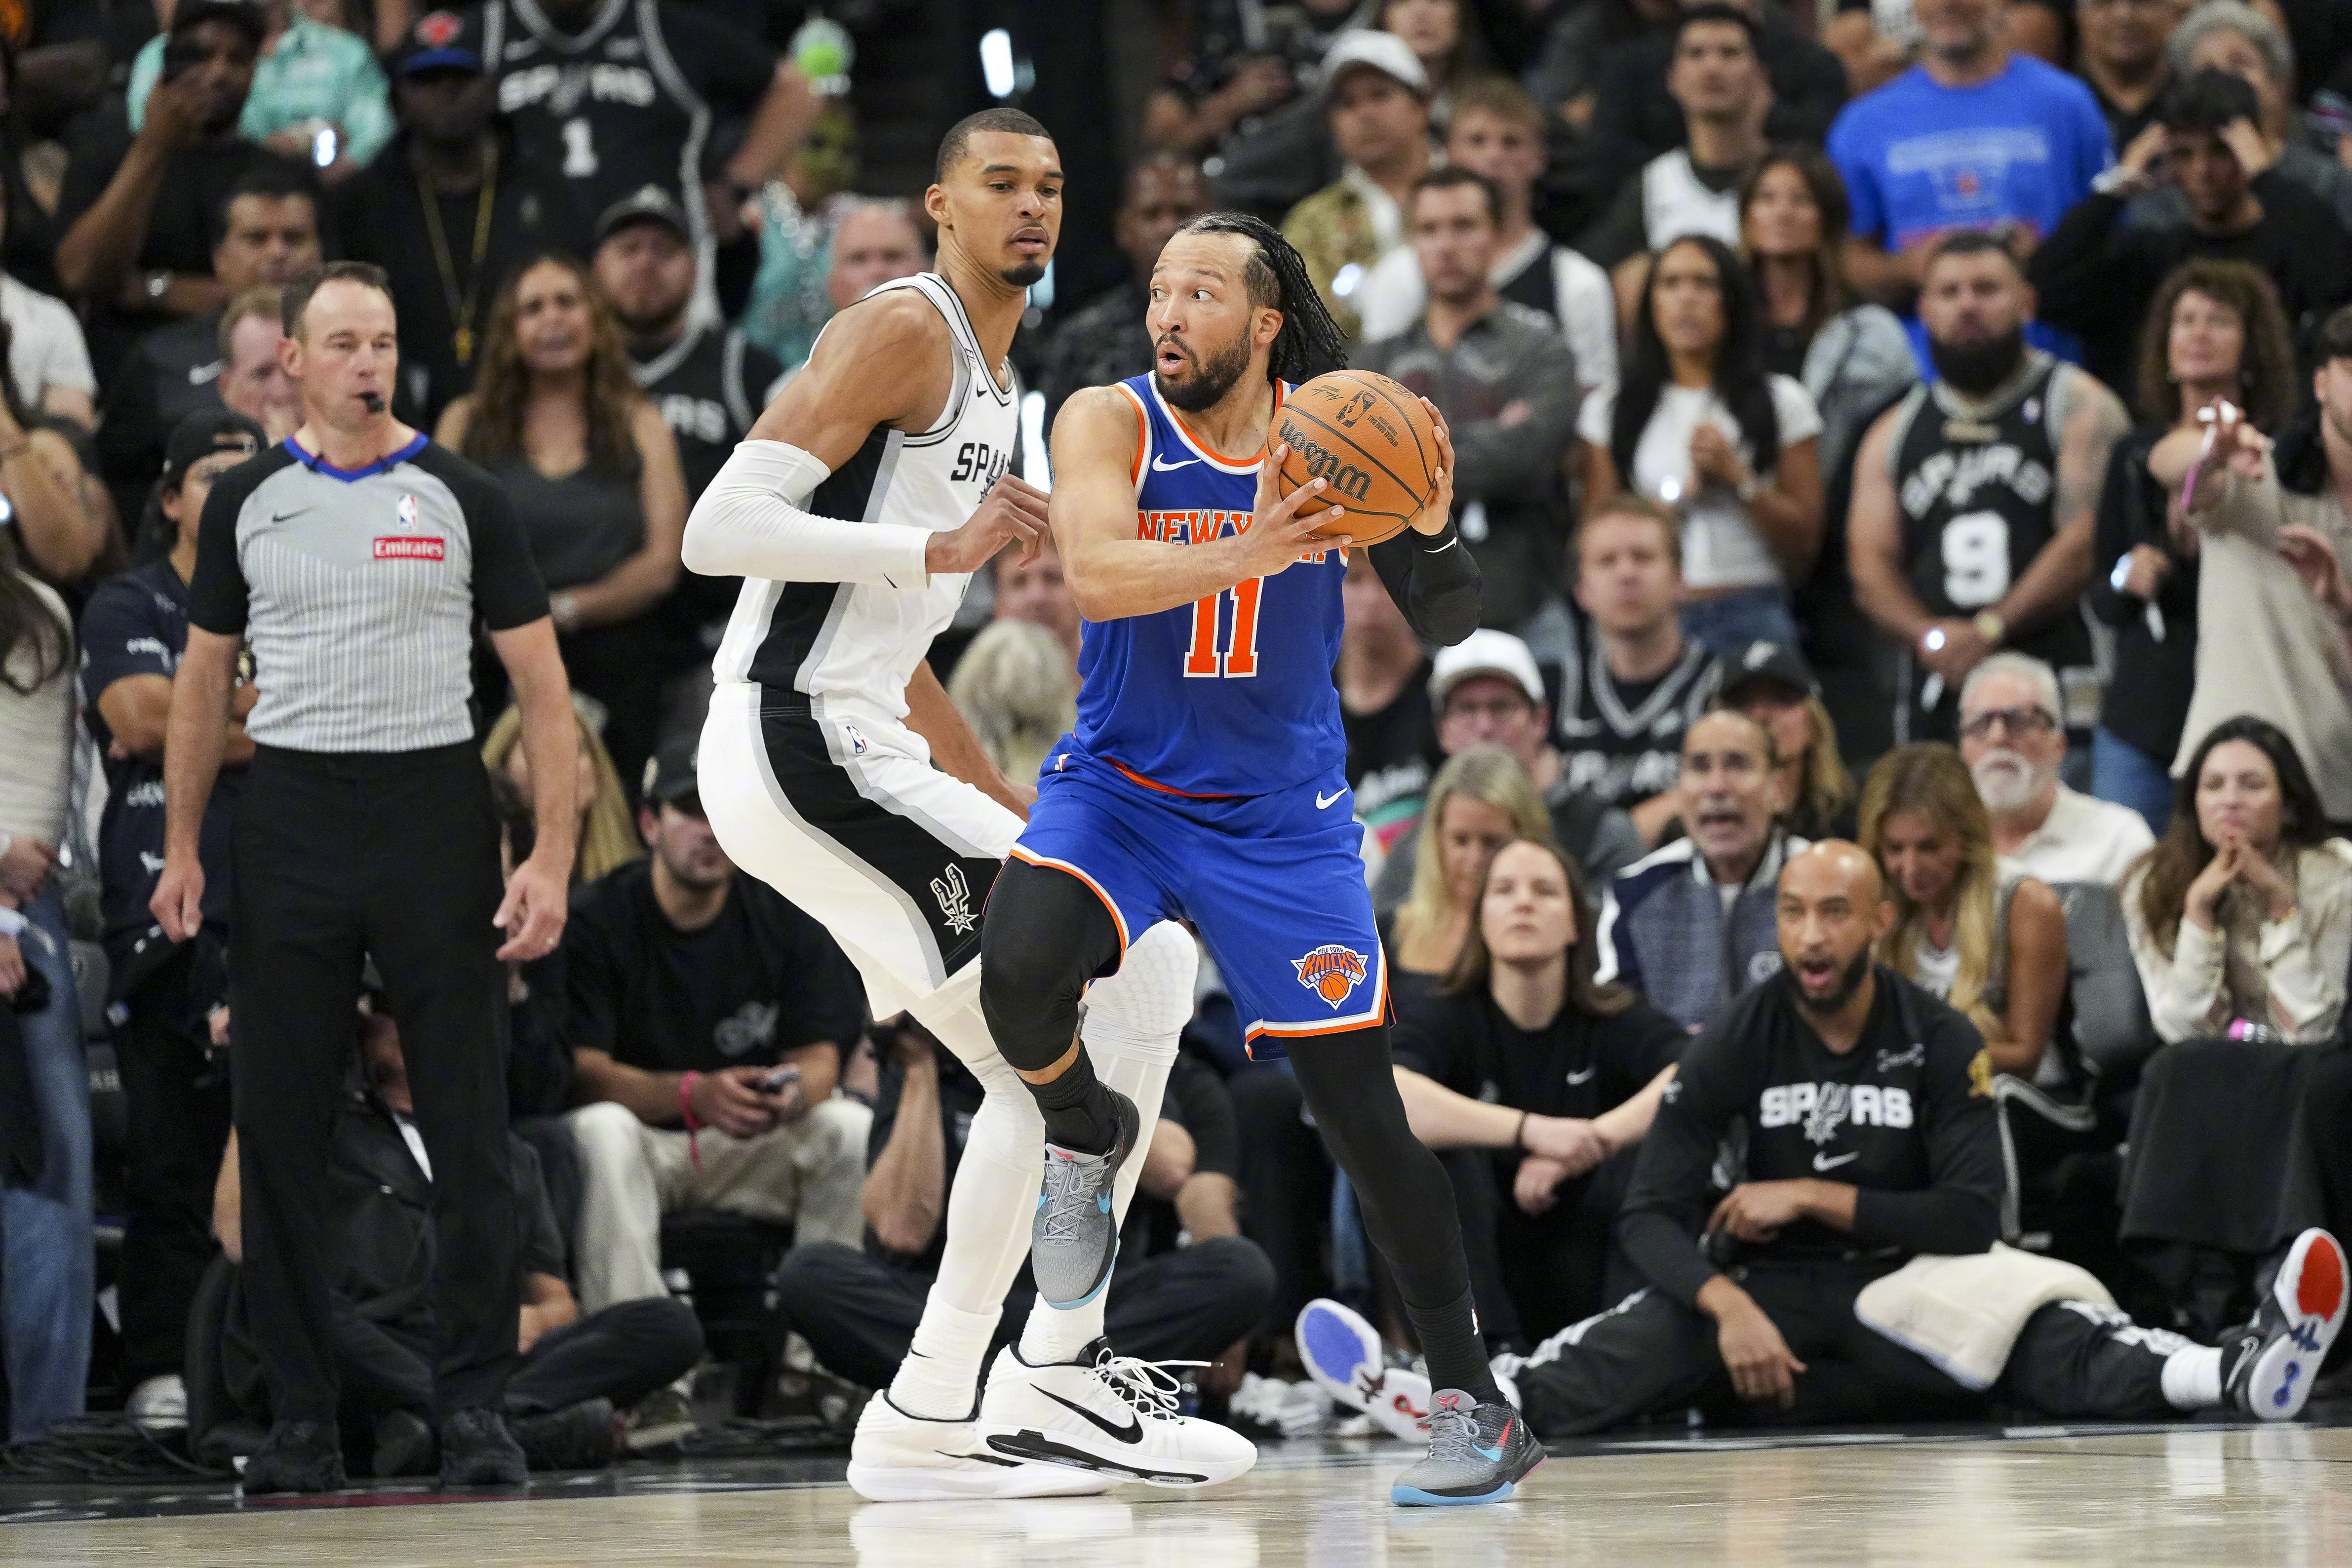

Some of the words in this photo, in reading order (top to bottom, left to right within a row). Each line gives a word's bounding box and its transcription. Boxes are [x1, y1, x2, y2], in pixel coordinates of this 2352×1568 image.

[561, 118, 599, 178] 1
[1367, 415, 1378, 426] BALL
[1374, 422, 1386, 433] GAME
[1383, 430, 1399, 448] OFFICIAL
[1137, 509, 1228, 546] NEW
[374, 538, 444, 558] Emirates
[1940, 510, 2011, 610] 9
[1183, 576, 1265, 678] 11
[1299, 951, 1365, 980] KNICKS
[1317, 947, 1329, 955] NEW
[1759, 1081, 1915, 1145] SPURS
